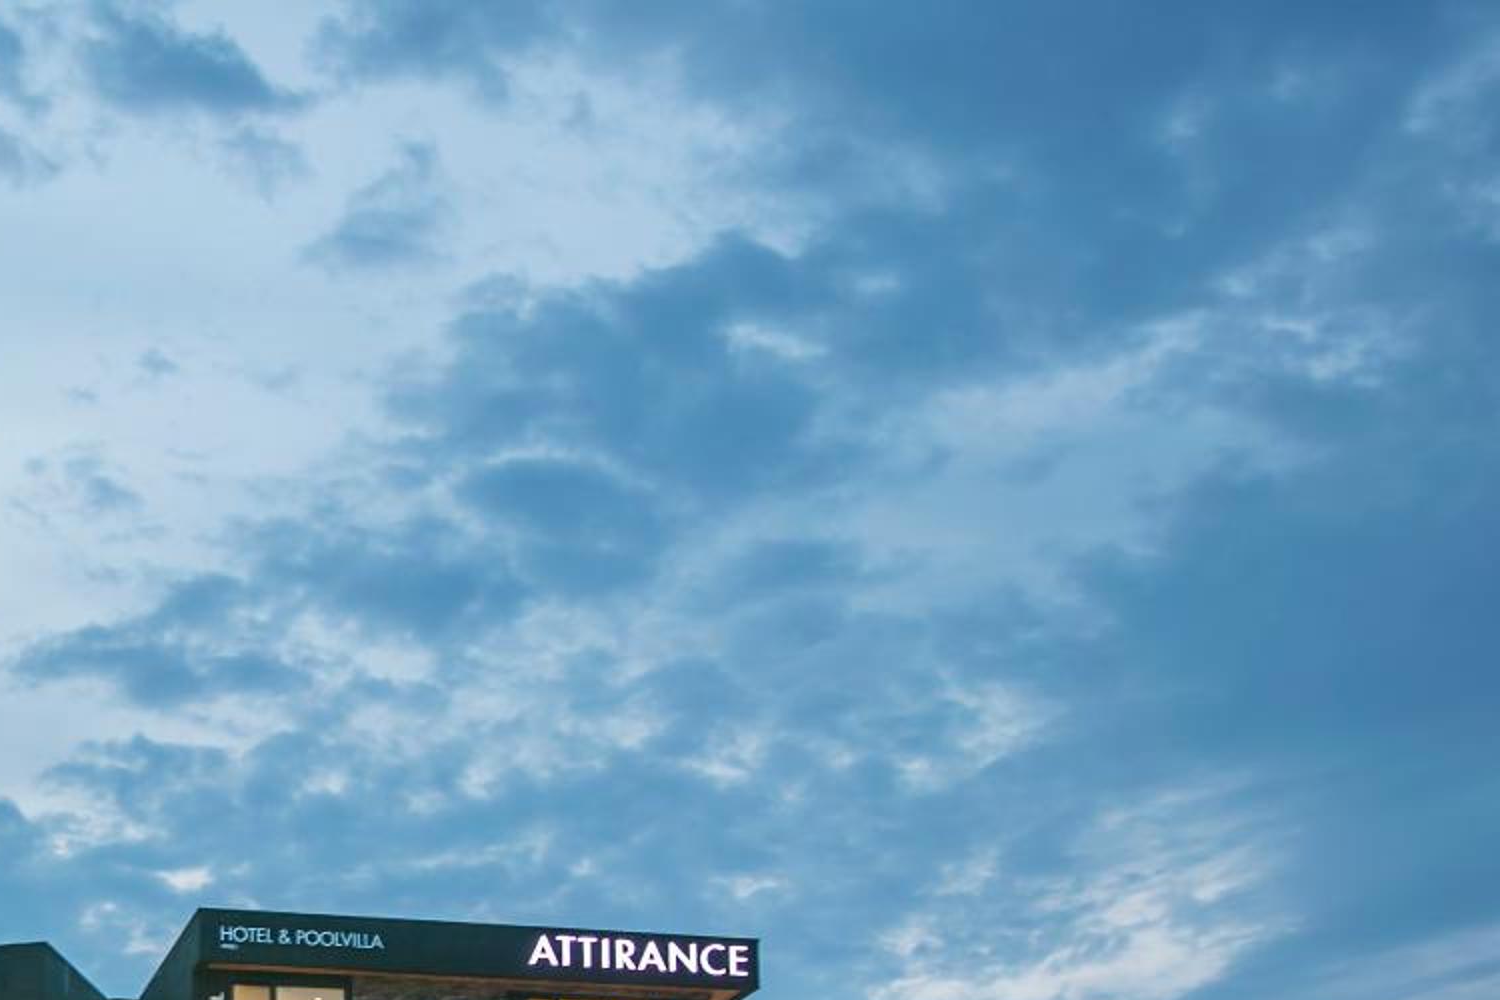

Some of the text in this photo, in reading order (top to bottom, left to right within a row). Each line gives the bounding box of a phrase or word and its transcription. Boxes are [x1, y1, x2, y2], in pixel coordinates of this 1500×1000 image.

[220, 926, 385, 949] HOTEL & POOLVILLA
[528, 934, 749, 977] ATTIRANCE
